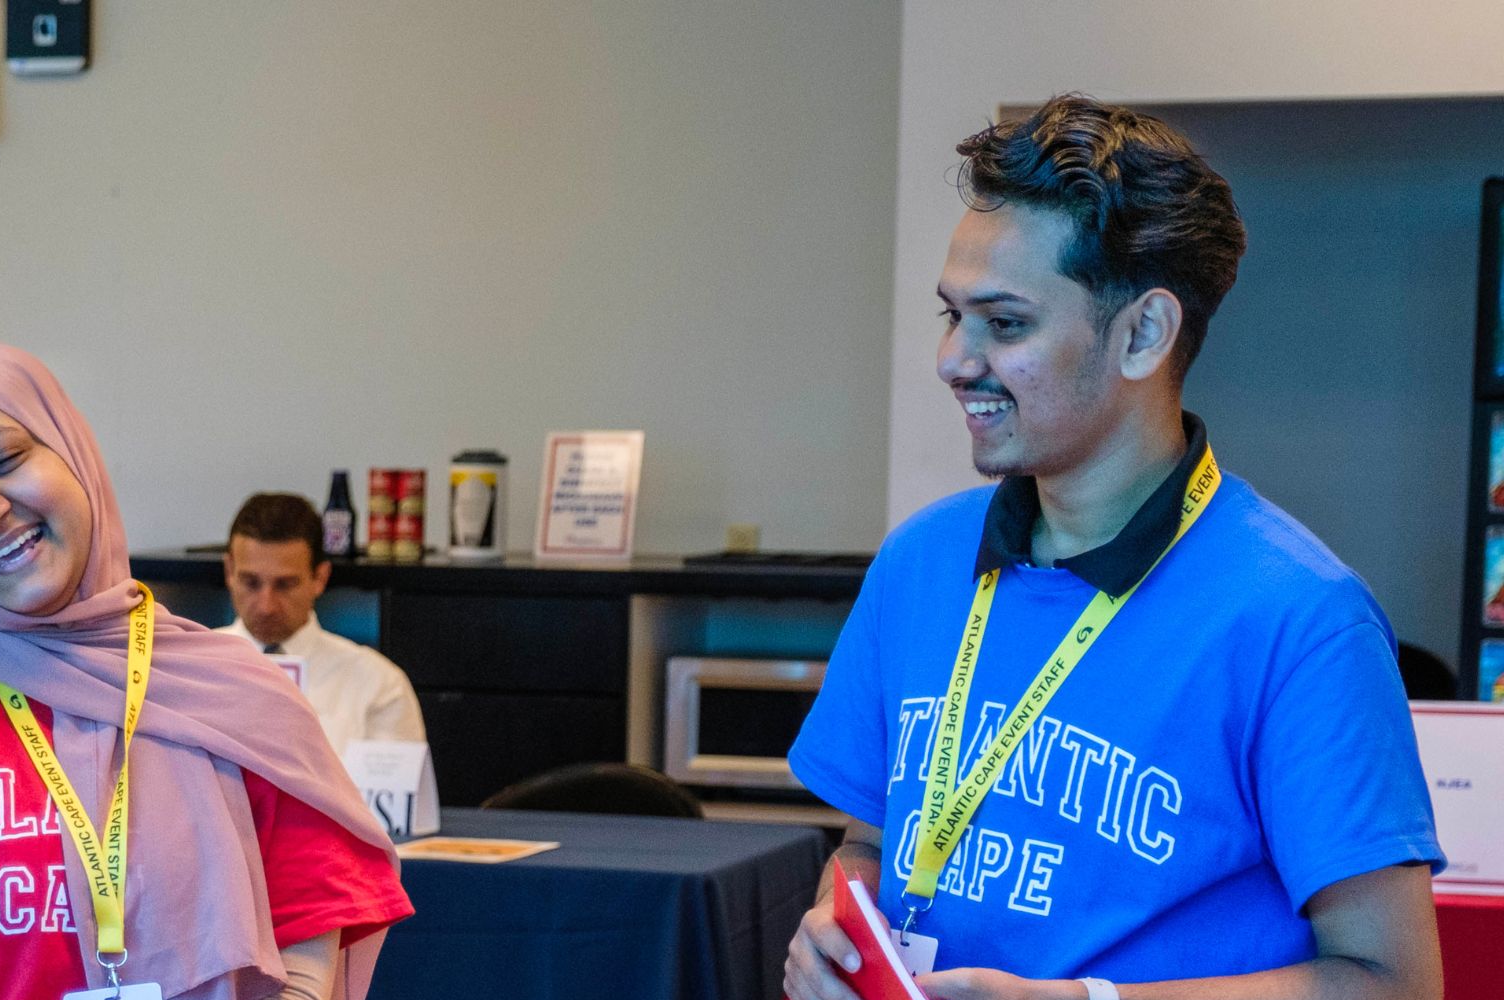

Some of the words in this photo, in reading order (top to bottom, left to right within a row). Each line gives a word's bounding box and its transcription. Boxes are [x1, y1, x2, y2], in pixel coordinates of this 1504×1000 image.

[1188, 464, 1216, 504] EVENT
[135, 621, 148, 656] STAFF
[955, 613, 982, 687] ATLANTIC
[944, 691, 962, 732] CAPE
[21, 724, 48, 759] STAFF
[933, 784, 978, 852] ATLANTIC
[975, 747, 1004, 786] CAPE
[1000, 702, 1035, 748] EVENT
[1032, 657, 1066, 702] STAFF
[935, 735, 954, 787] EVENT
[40, 761, 70, 797] EVENT
[62, 798, 87, 829] CAPE
[108, 807, 122, 850] EVENT
[78, 829, 110, 898] ATLANTIC
